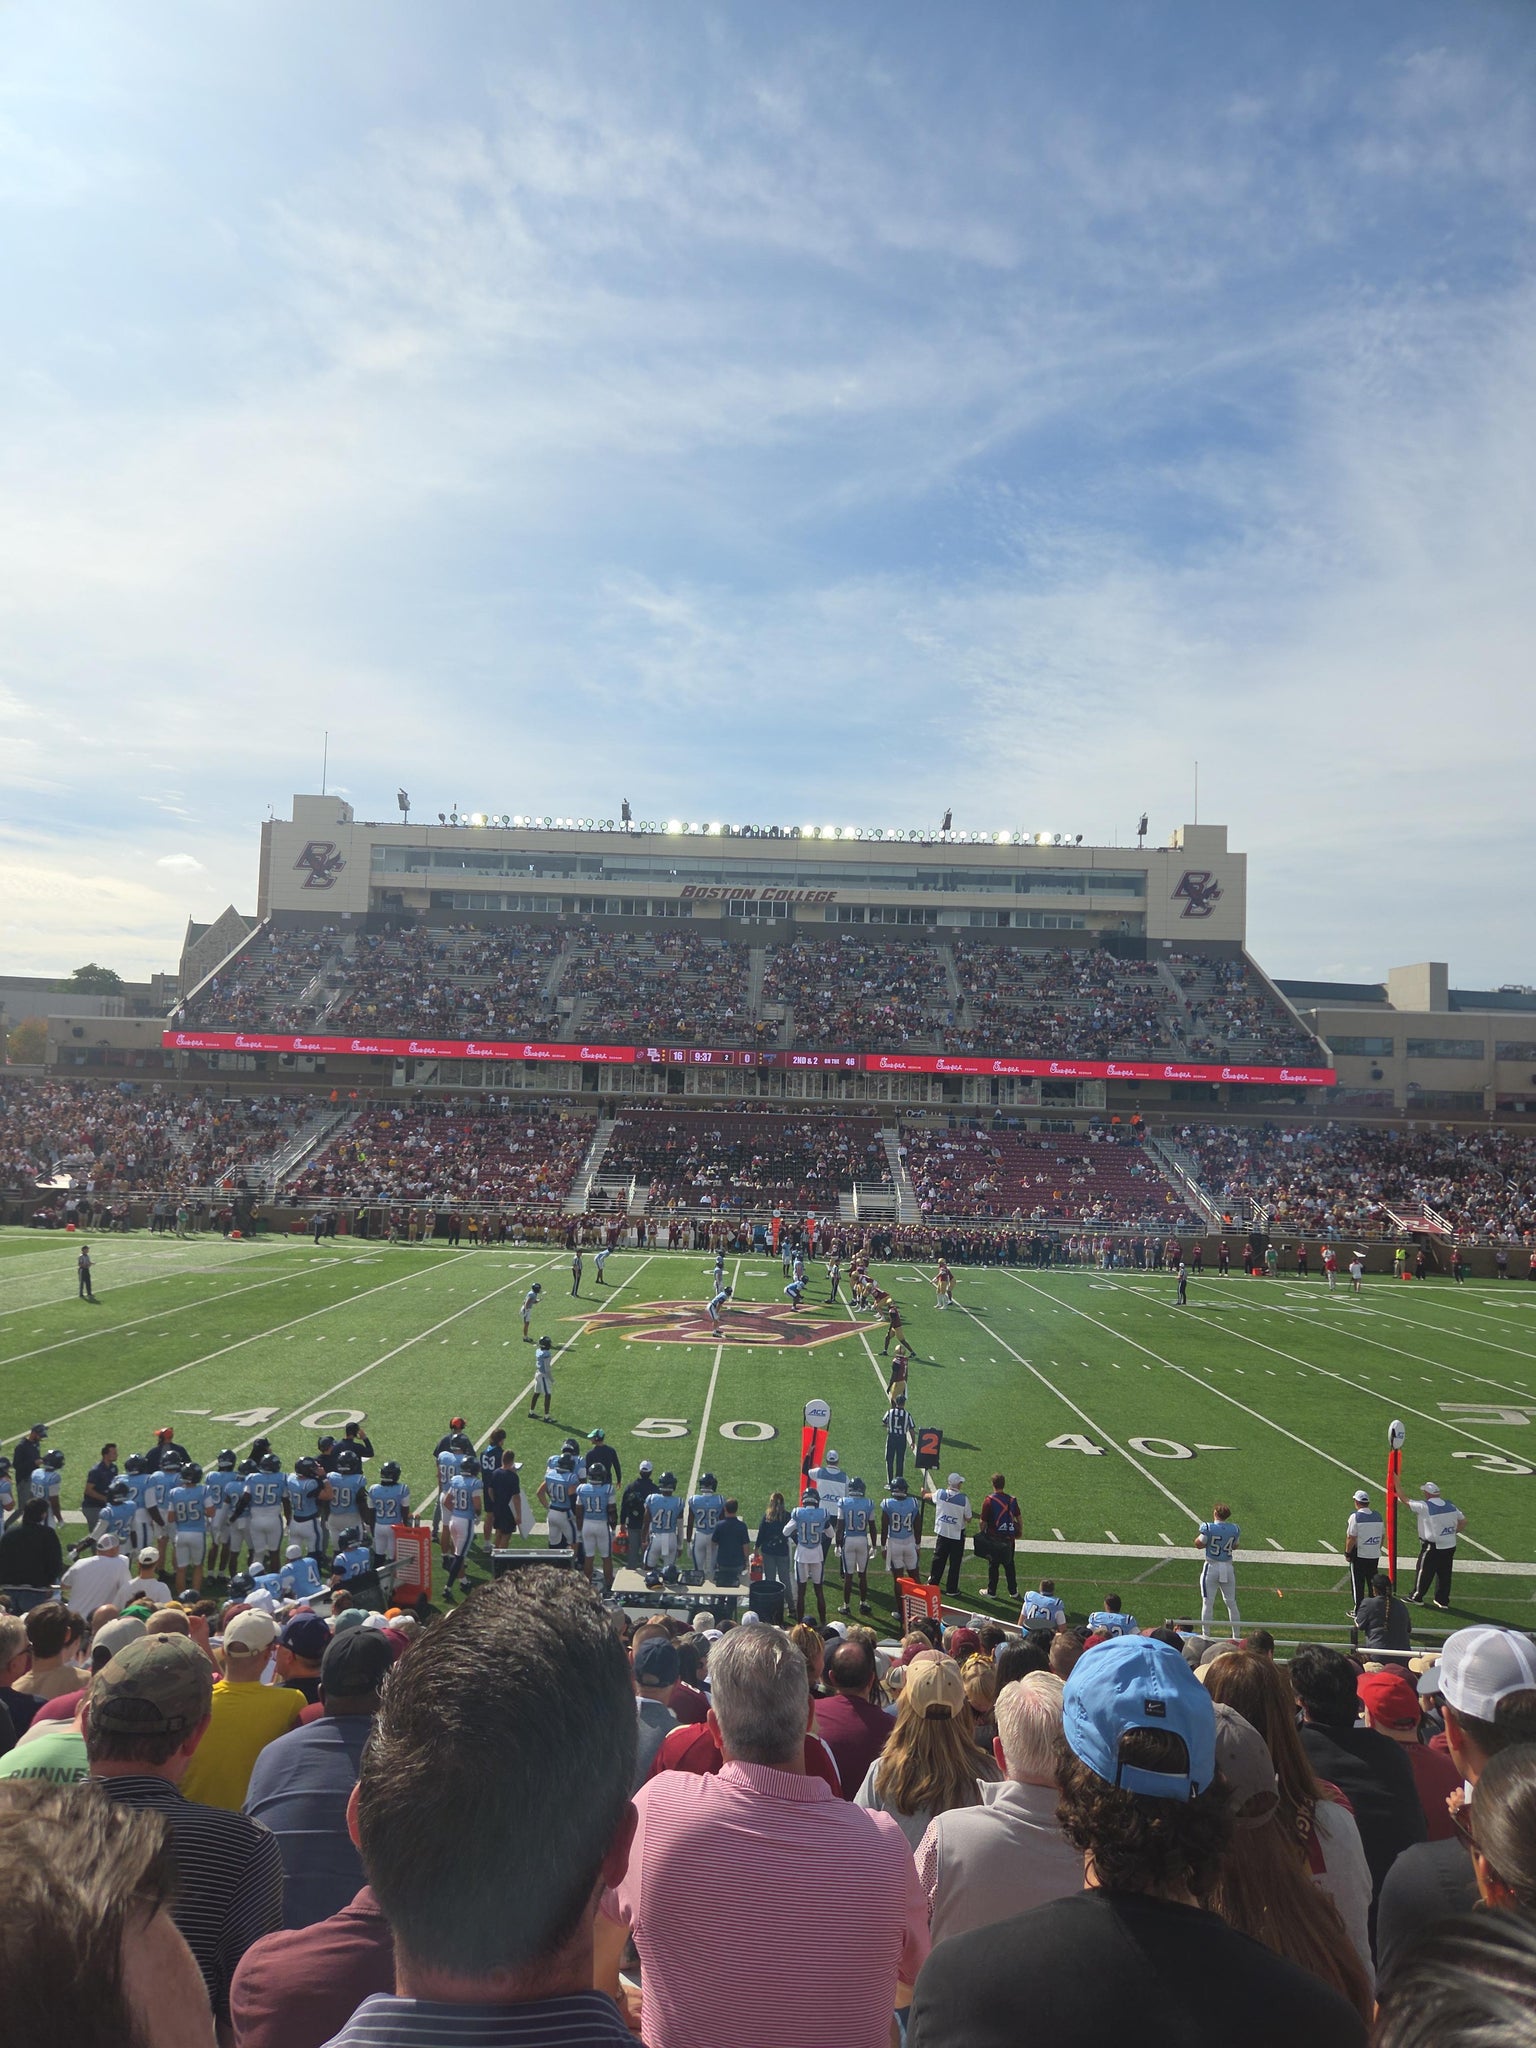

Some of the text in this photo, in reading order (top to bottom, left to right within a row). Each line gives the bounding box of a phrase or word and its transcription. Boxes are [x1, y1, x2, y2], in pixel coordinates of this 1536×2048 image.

[680, 885, 838, 903] BOSTON COLLEGE
[673, 1052, 682, 1060] 16
[695, 1052, 712, 1061] 9:37
[744, 1054, 750, 1063] 0
[792, 1056, 806, 1064] 2ND
[807, 1057, 812, 1065] &
[813, 1057, 818, 1065] 2
[845, 1058, 855, 1066] 46
[808, 1408, 827, 1417] ACC
[894, 1416, 902, 1428] L
[631, 1417, 777, 1442] 50
[920, 1433, 939, 1455] 2
[1045, 1434, 1193, 1459] 40
[482, 1454, 496, 1470] 53
[254, 1484, 278, 1505] 95
[176, 1500, 200, 1522] 85
[375, 1498, 397, 1518] 32
[586, 1496, 602, 1513] 11
[653, 1508, 672, 1530] 41
[696, 1508, 717, 1529] 26
[848, 1510, 867, 1532] 13
[891, 1512, 912, 1532] 84
[938, 1514, 958, 1524] ACC
[800, 1521, 820, 1544] 15
[1363, 1536, 1381, 1545] ACC
[1440, 1526, 1455, 1536] ACC
[1210, 1535, 1235, 1556] 54
